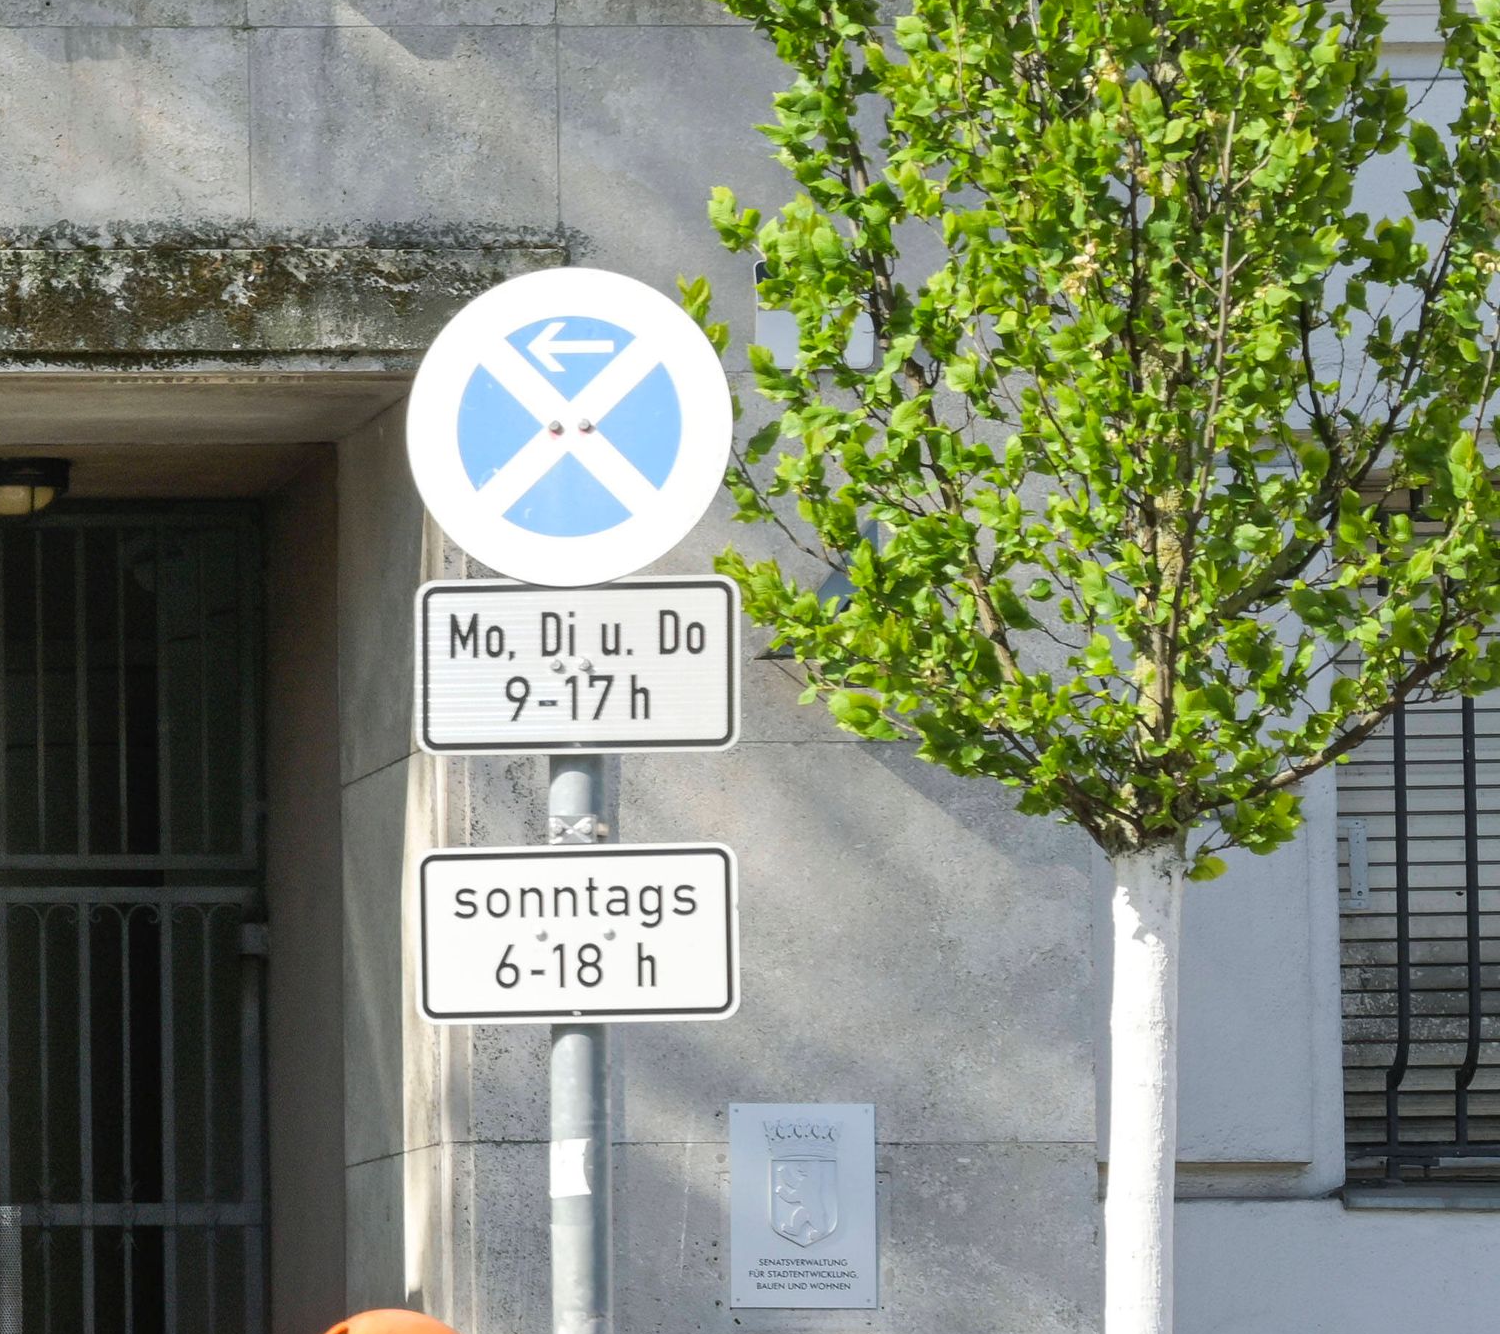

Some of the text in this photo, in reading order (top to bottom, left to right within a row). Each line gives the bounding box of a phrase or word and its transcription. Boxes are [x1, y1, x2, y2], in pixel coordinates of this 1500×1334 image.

[450, 610, 706, 661] Mo, Di u. Do
[506, 675, 614, 722] 9-17
[453, 876, 698, 927] sonntags
[495, 942, 657, 988] 6-18 h
[748, 1269, 765, 1278] FÜR
[756, 1282, 851, 1290] BAUEN UND WOHNEN
